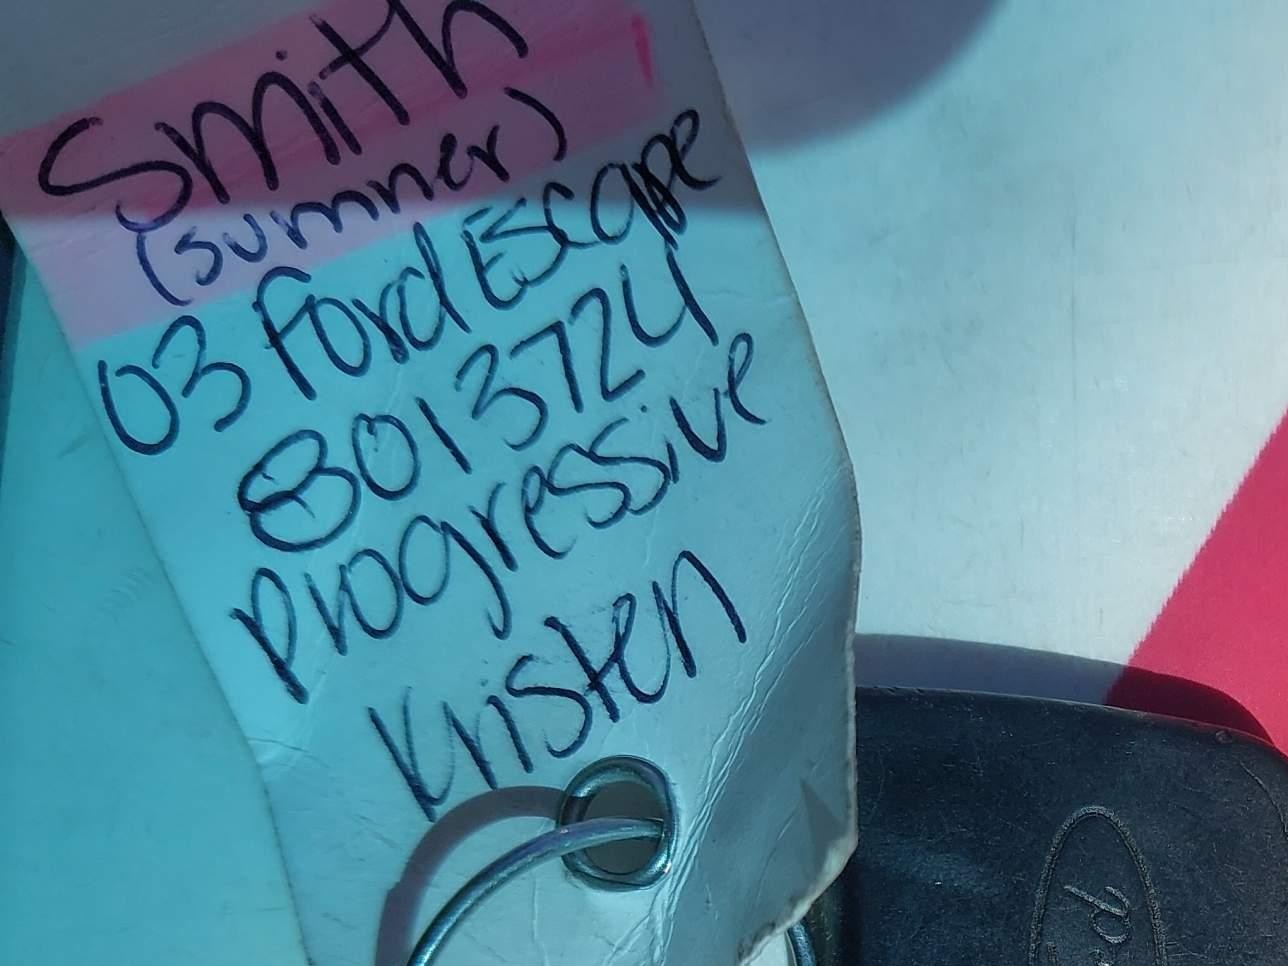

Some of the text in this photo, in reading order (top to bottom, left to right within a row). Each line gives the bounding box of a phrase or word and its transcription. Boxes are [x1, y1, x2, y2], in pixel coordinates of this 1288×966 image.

[37, 0, 530, 233] Smith
[98, 315, 251, 455] 03
[237, 246, 719, 552] 8013724
